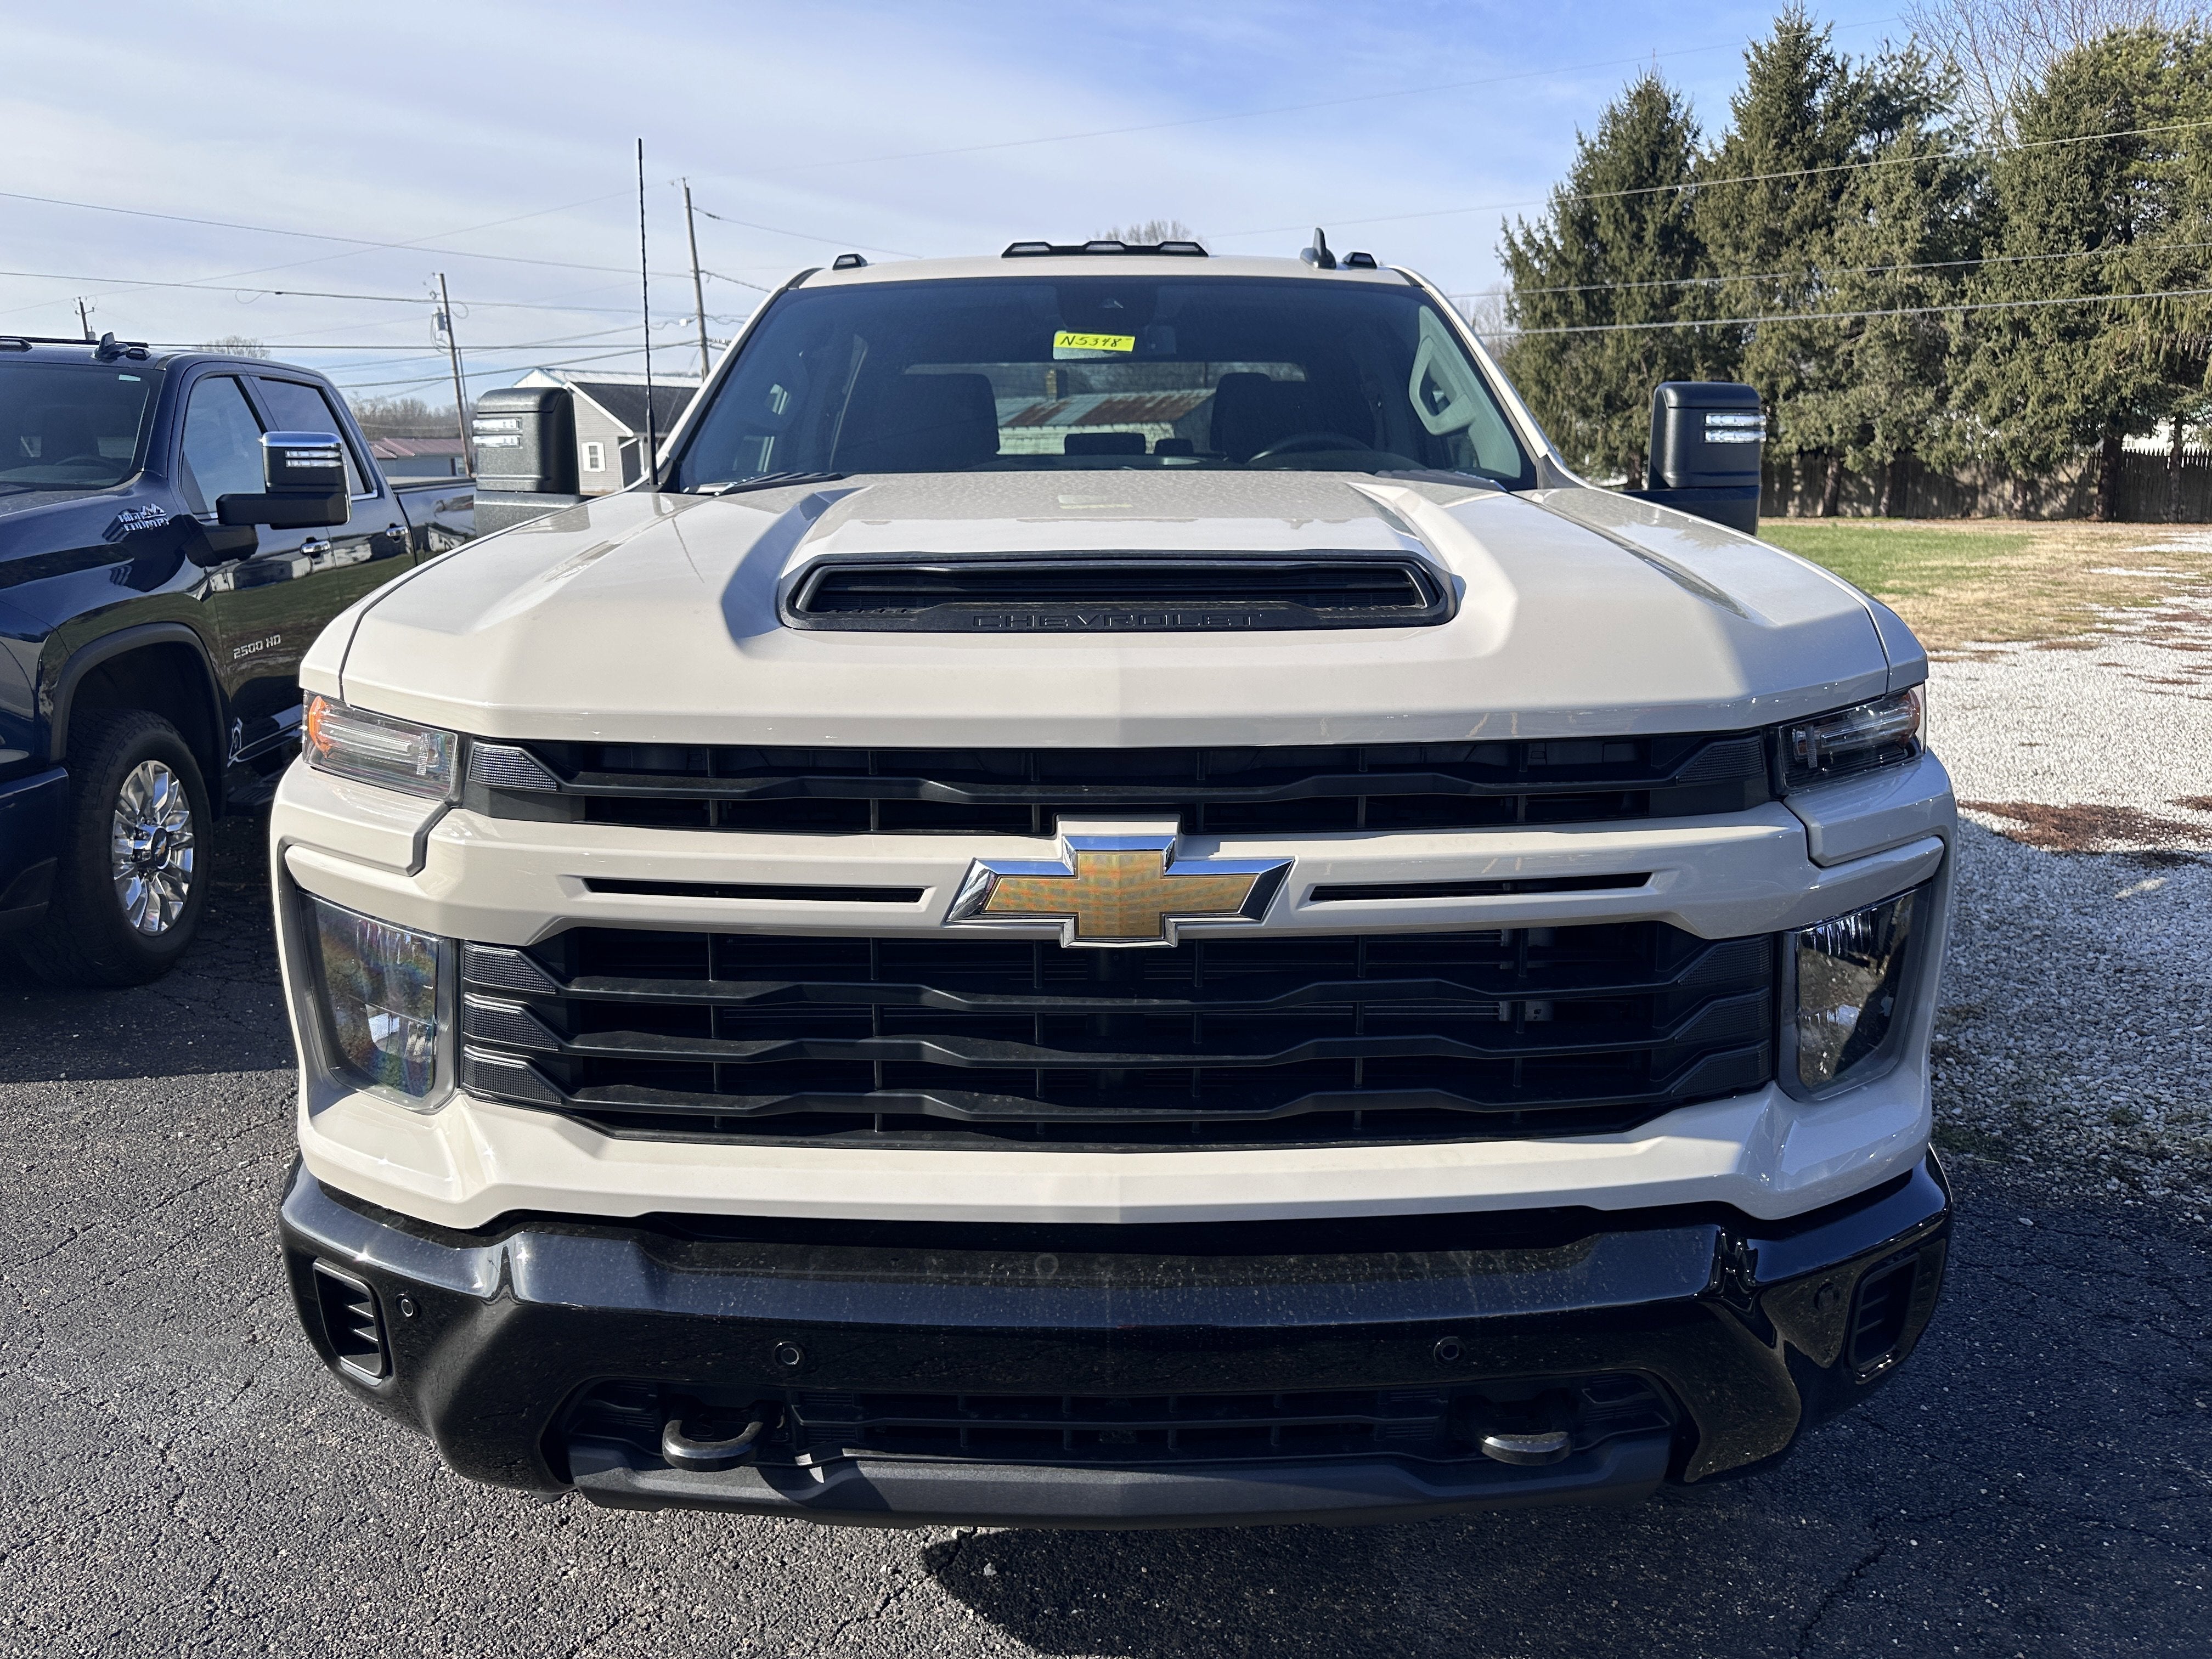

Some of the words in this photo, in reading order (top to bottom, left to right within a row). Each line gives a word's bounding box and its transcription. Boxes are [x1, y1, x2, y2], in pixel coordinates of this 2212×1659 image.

[973, 614, 1262, 628] CHEVROLET
[233, 640, 263, 659] 2500
[265, 634, 281, 648] HD
